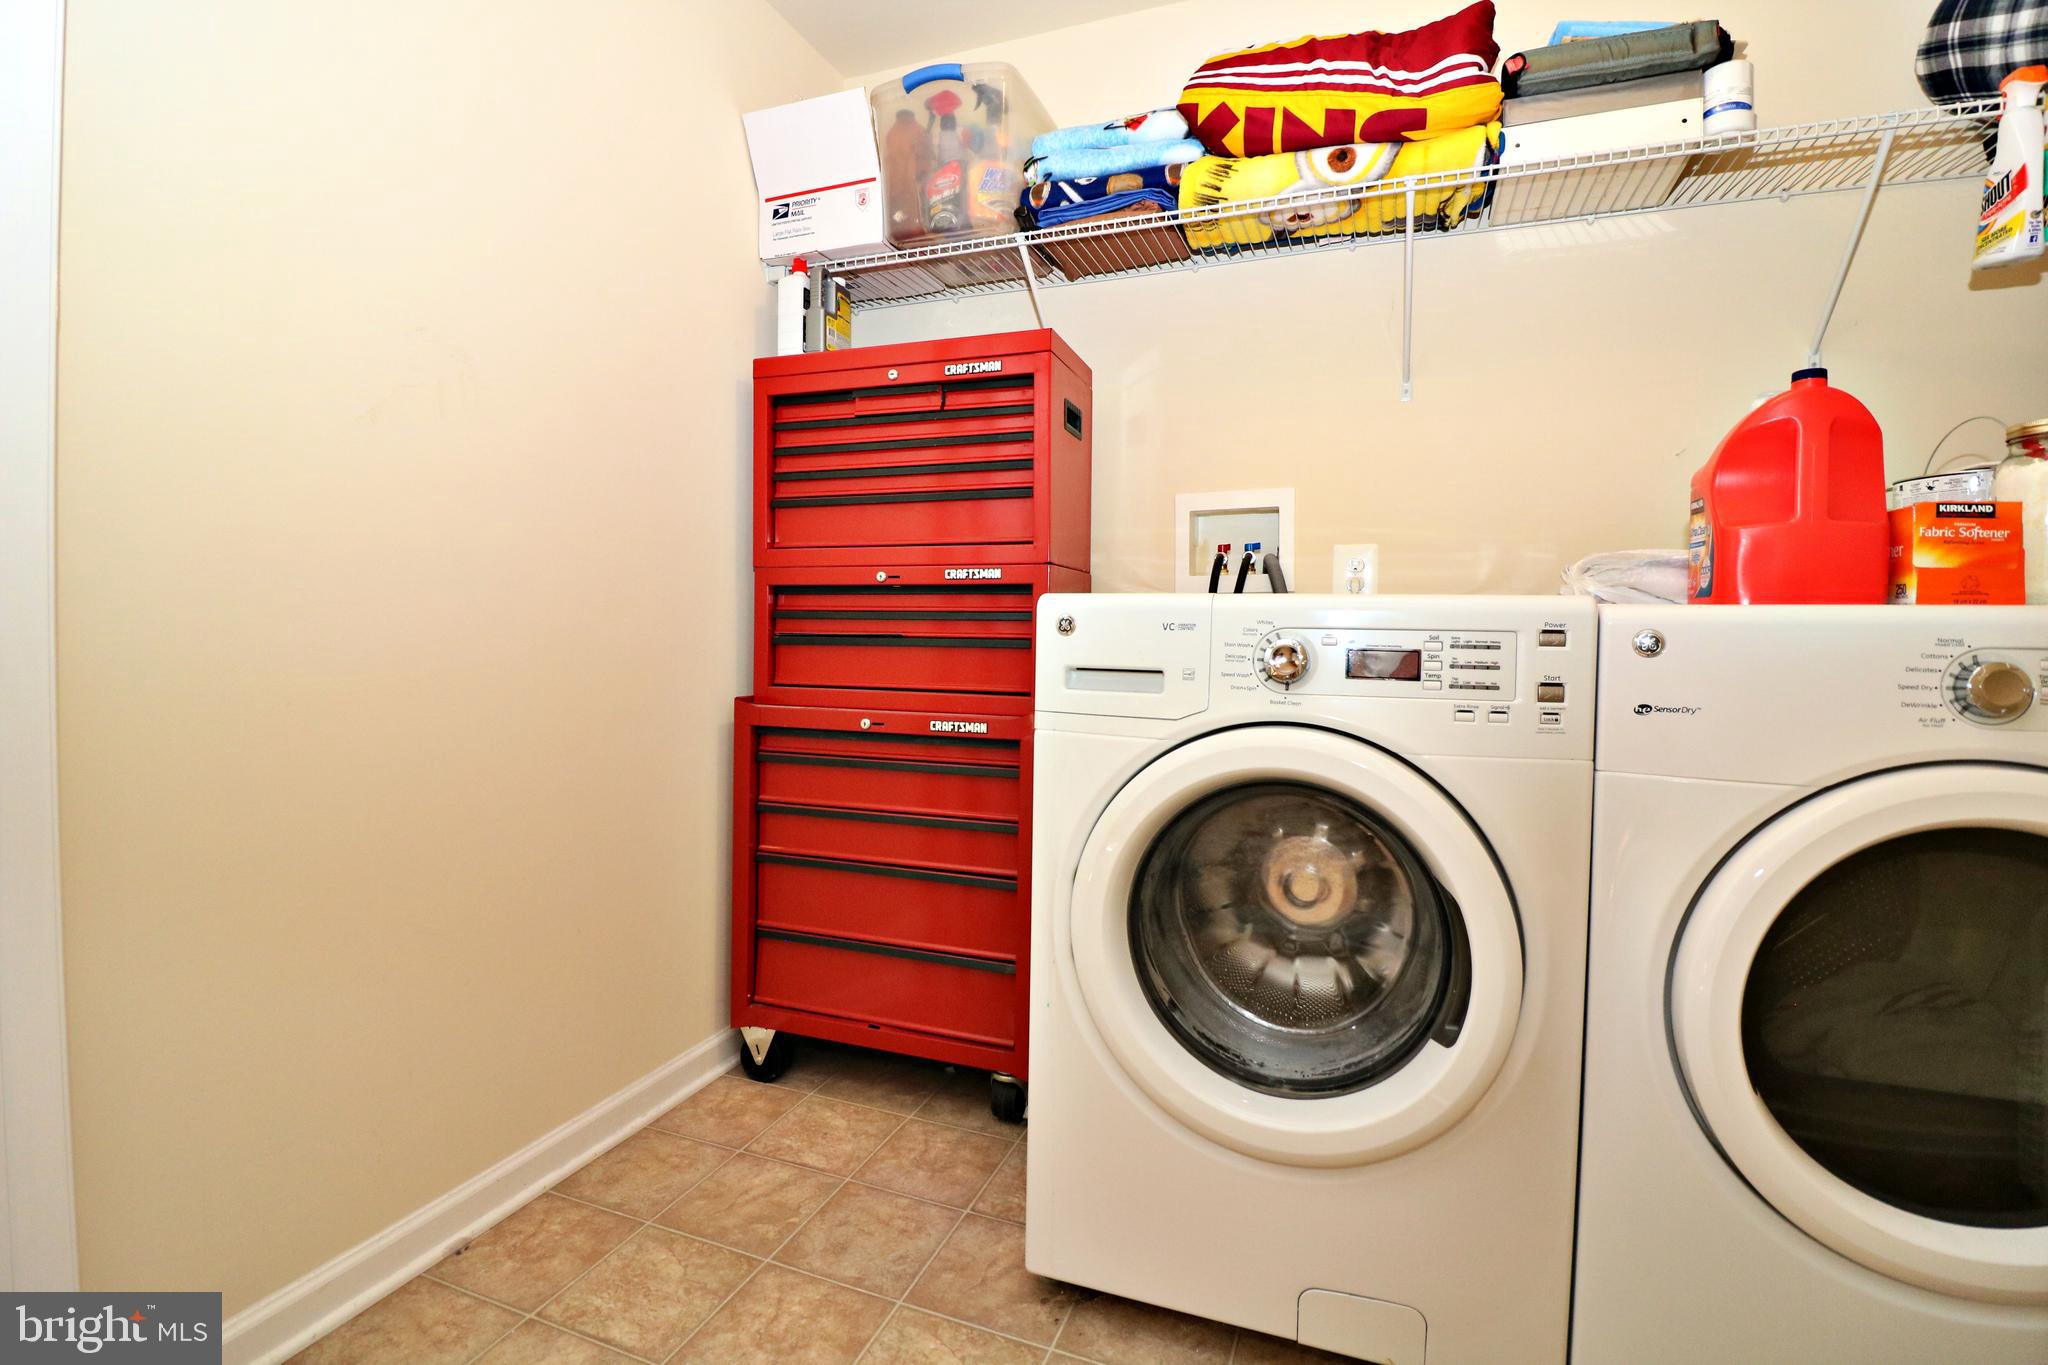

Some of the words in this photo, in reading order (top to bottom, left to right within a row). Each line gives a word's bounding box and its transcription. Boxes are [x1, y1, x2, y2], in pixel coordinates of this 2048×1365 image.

[791, 197, 817, 207] PRIORITY
[944, 360, 1002, 376] CRAFTSMAN
[1939, 504, 1994, 513] KIRKLAND
[1919, 527, 1955, 538] Fabric
[1959, 526, 2011, 539] Softener
[944, 568, 1002, 580] CRAFTSMAN
[1895, 583, 1907, 595] 250
[1162, 622, 1175, 631] VC
[1544, 621, 1566, 629] Power
[1427, 653, 1440, 661] Spin
[1425, 672, 1442, 680] Temp
[1543, 674, 1561, 682] Start
[1921, 684, 1934, 692] Dry
[1901, 701, 1938, 709] DeWrinkle
[929, 720, 988, 735] CRAFTSMAN
